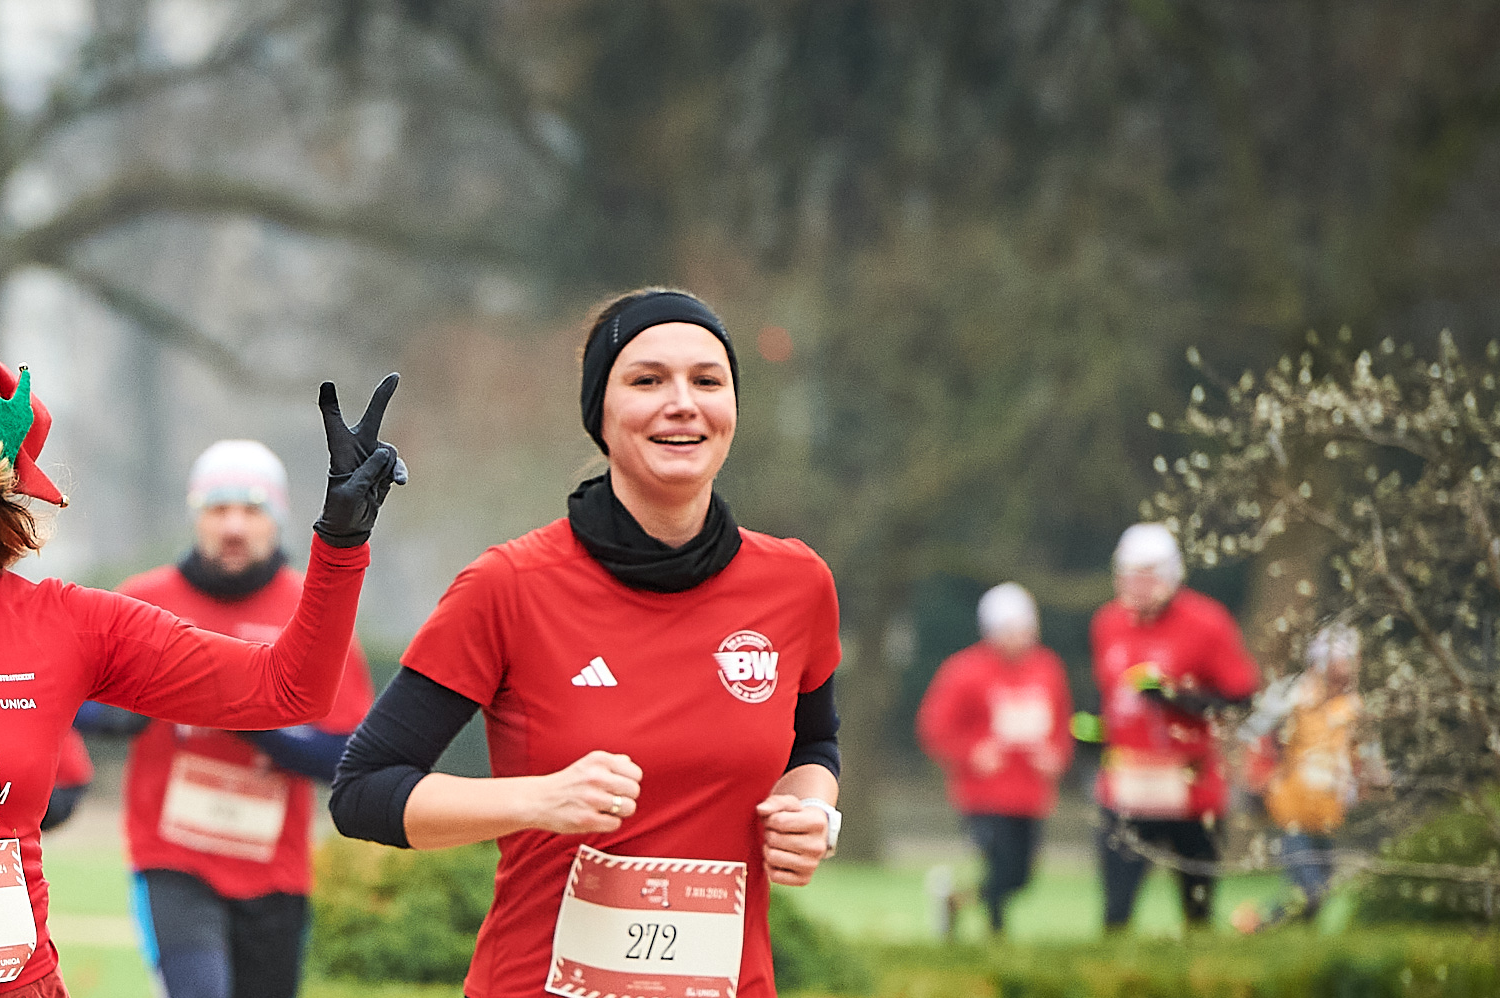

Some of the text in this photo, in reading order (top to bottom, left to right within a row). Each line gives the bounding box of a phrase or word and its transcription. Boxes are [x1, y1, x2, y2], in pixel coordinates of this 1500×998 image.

[721, 651, 779, 681] BW
[0, 699, 37, 709] UNIQA
[625, 923, 677, 960] 272
[0, 957, 21, 967] UNIQA
